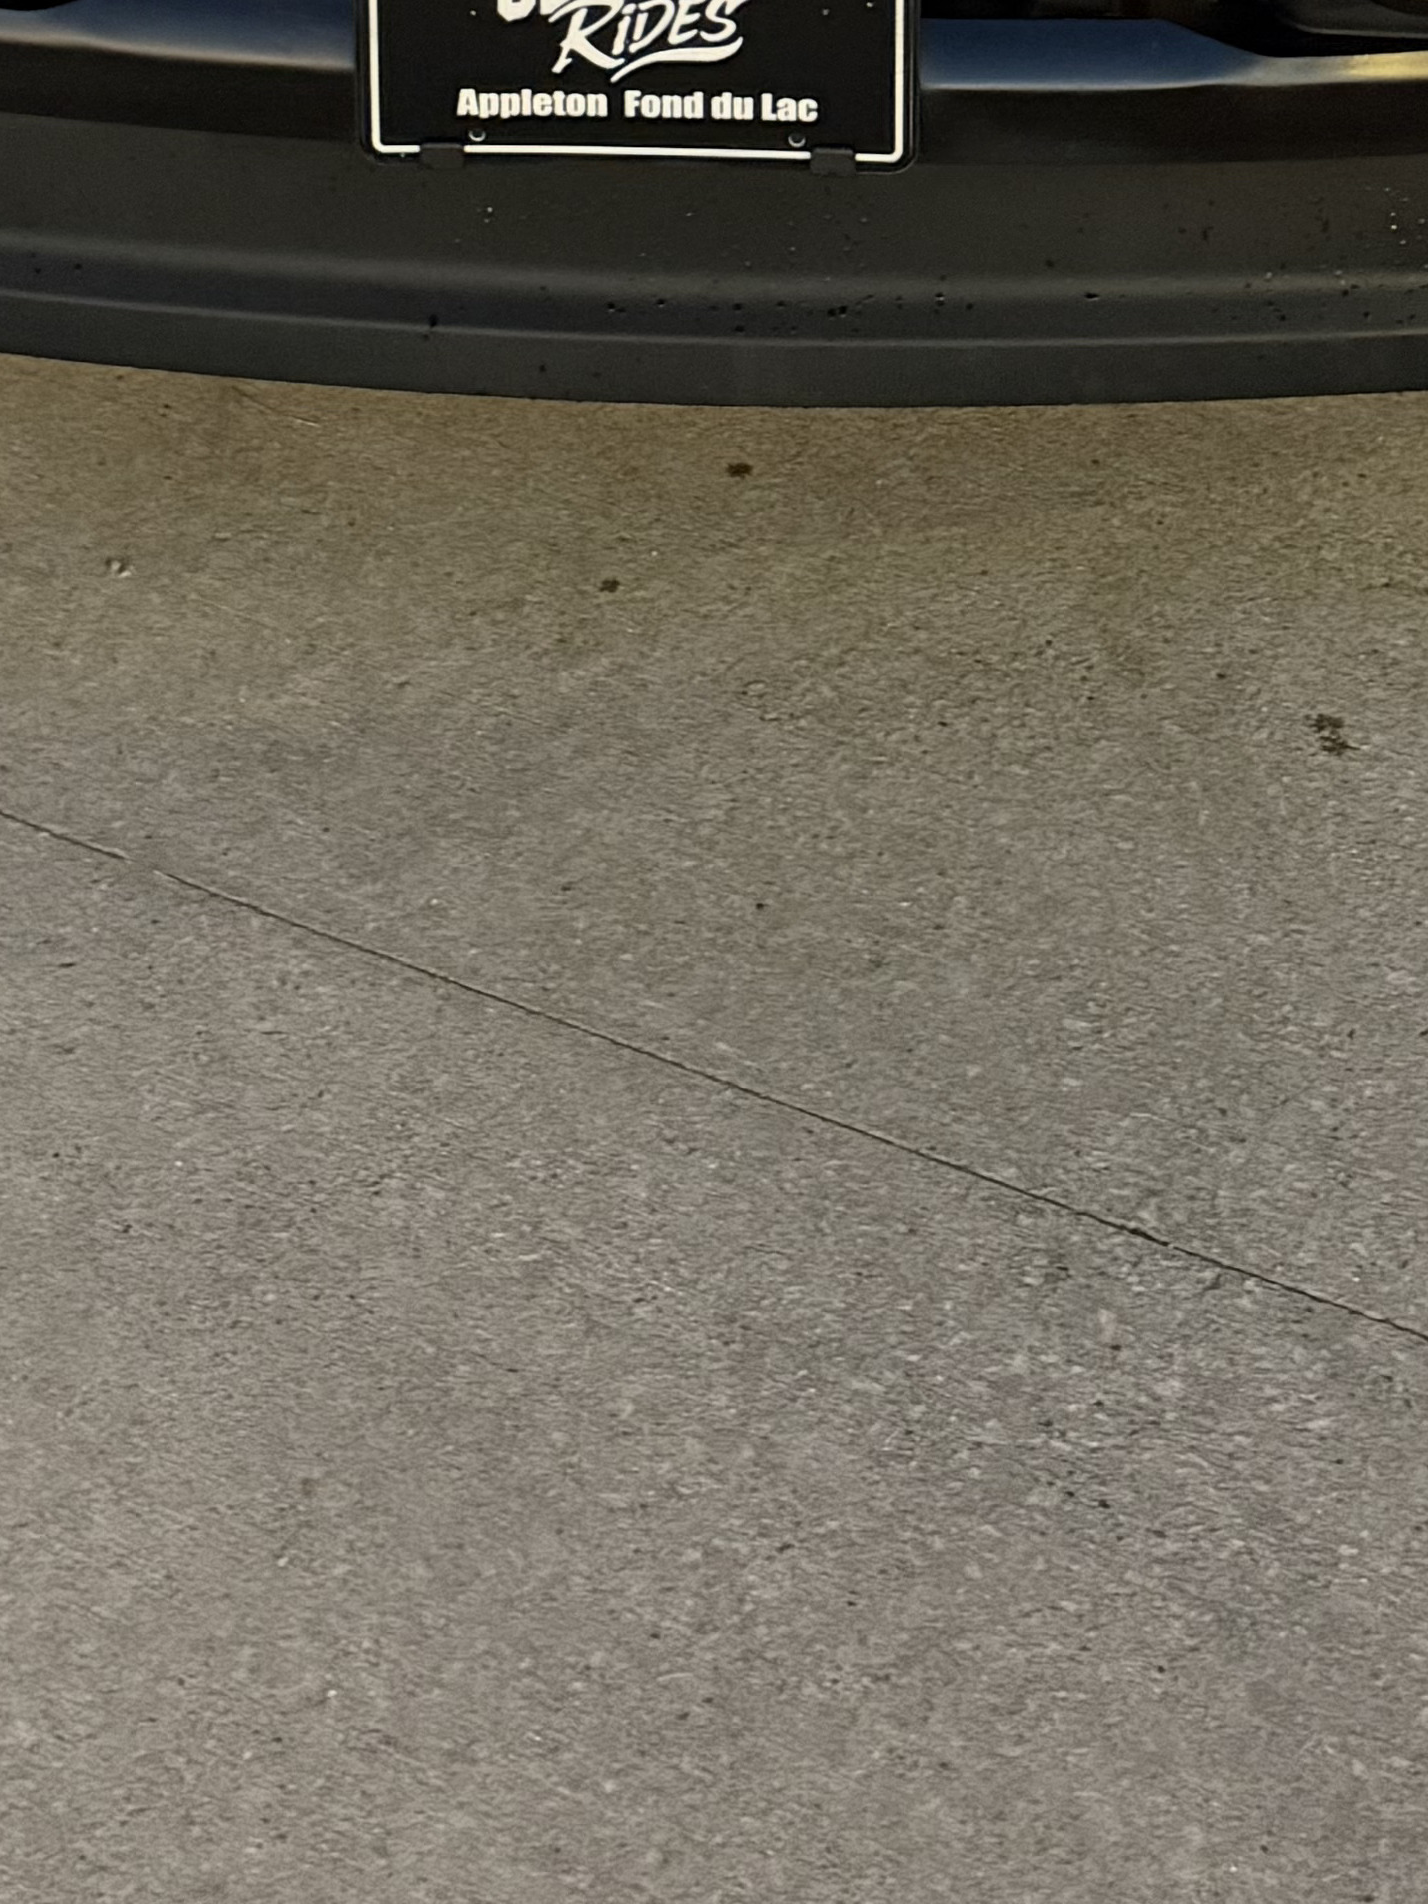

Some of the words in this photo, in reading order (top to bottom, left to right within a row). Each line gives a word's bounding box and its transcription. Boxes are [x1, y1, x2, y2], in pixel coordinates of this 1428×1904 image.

[457, 88, 608, 119] Appleton
[623, 89, 704, 120] Fond
[711, 92, 755, 121] du
[760, 93, 819, 123] Lac
